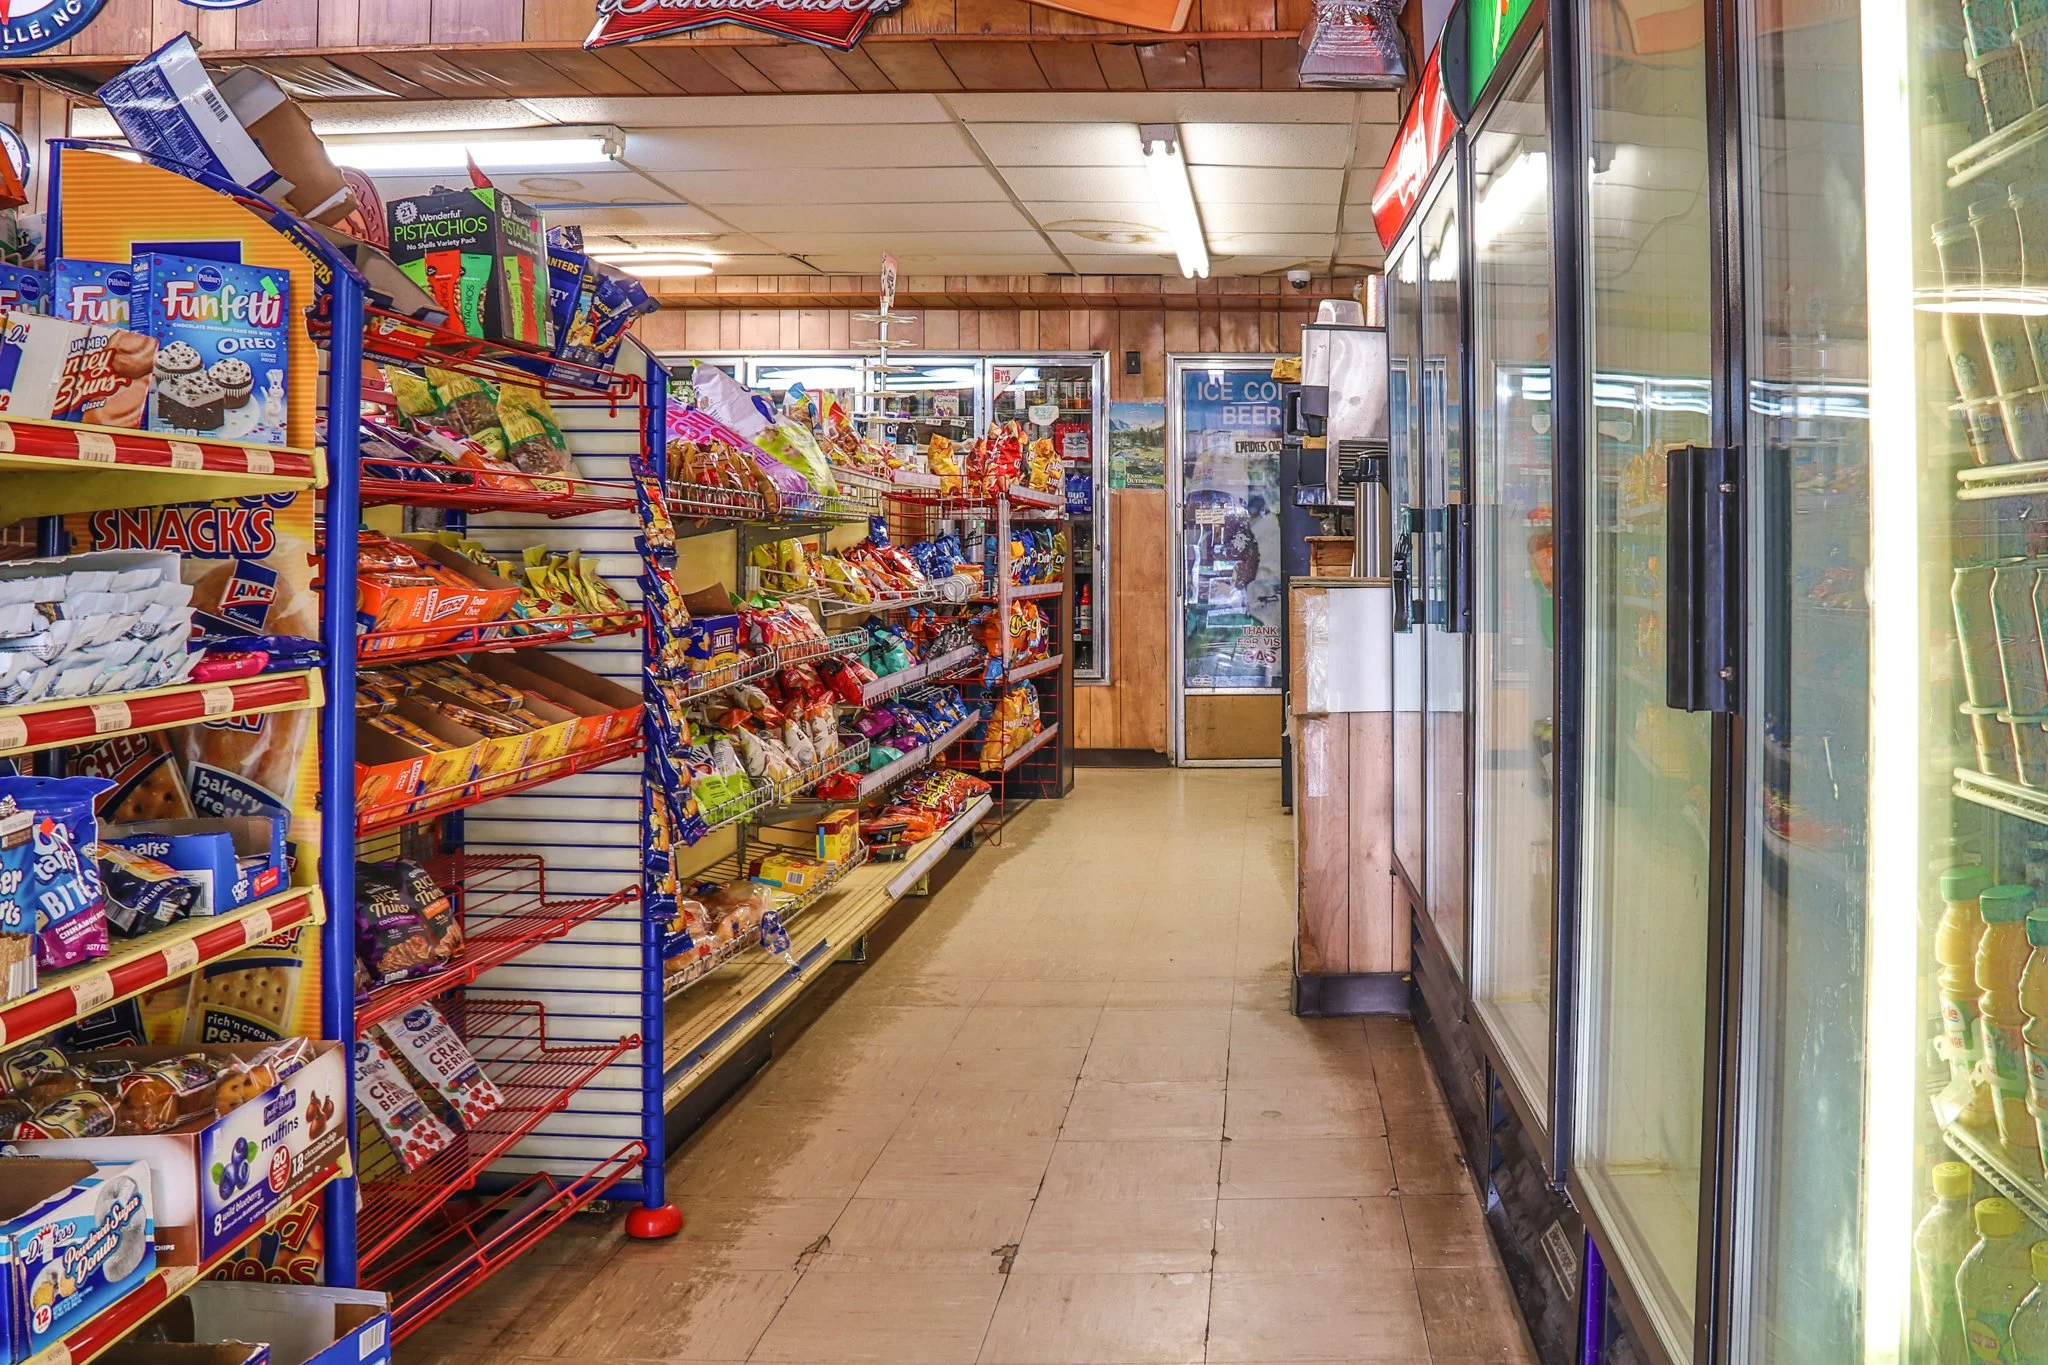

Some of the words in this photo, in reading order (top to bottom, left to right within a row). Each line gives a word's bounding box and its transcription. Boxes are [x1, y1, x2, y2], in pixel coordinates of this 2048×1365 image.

[51, 0, 82, 27] NC
[419, 209, 461, 222] Wonderful
[393, 216, 488, 242] PISTACHIOS
[417, 242, 436, 250] Shells
[436, 240, 460, 248] Variety
[460, 237, 476, 245] Pack
[198, 274, 221, 286] Pillsbury
[68, 285, 131, 322] Fun
[162, 281, 281, 326] Funfetti
[172, 322, 206, 330] CHOCOLATE
[206, 325, 233, 333] PREMIUM
[217, 337, 277, 355] OREO
[1197, 381, 1234, 401] ICE
[1222, 405, 1281, 425] BEER
[1067, 491, 1085, 499] BUD
[93, 507, 275, 554] SNACKS
[225, 579, 276, 604] LANCE
[471, 595, 489, 606] Toast
[227, 608, 260, 625] Freshness
[464, 605, 480, 616] Chee
[1241, 626, 1278, 636] THANK
[1237, 637, 1259, 647] FOR
[199, 770, 264, 815] bakery
[38, 869, 103, 921] BITES
[370, 888, 400, 904] RICE
[369, 899, 410, 918] Thins
[55, 918, 77, 935] frosted
[379, 916, 399, 926] COCOA
[429, 1039, 462, 1065] CRAN
[261, 1117, 299, 1152] muffins
[272, 1148, 287, 1171] 20
[291, 1153, 304, 1178] 12
[325, 1132, 337, 1148] chip
[214, 1213, 223, 1237] 8
[222, 1206, 236, 1222] wild
[235, 1190, 262, 1213] blueberry
[64, 1217, 114, 1274] Powdered
[110, 1196, 140, 1229] Sugar
[154, 1244, 175, 1252] CHIPS
[75, 1233, 119, 1284] Donuts
[35, 1308, 49, 1326] 12
